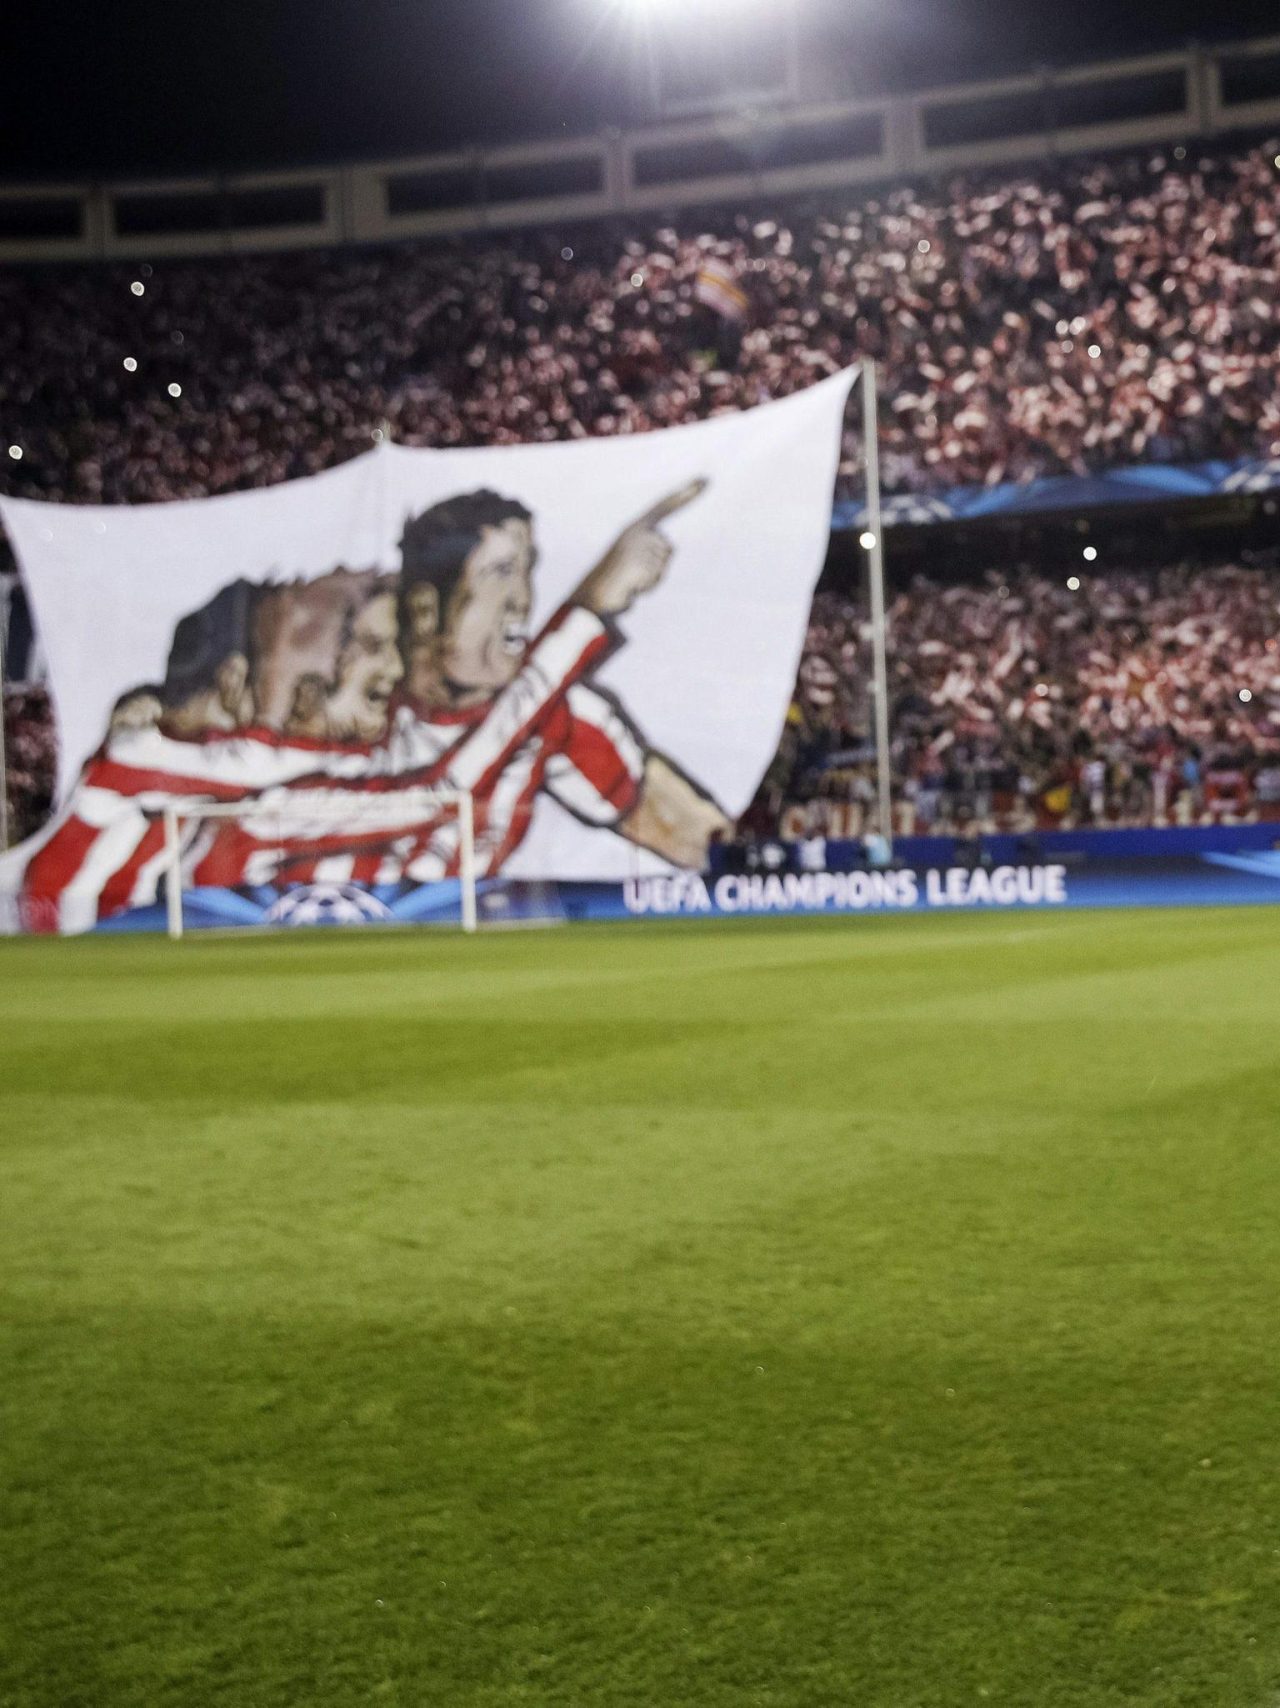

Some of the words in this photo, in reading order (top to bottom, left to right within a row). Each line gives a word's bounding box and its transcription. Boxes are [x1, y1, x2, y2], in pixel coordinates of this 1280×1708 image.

[623, 873, 712, 913] UEFA
[715, 868, 918, 912] CHAMPIONS
[926, 864, 1067, 905] LEAGUE
